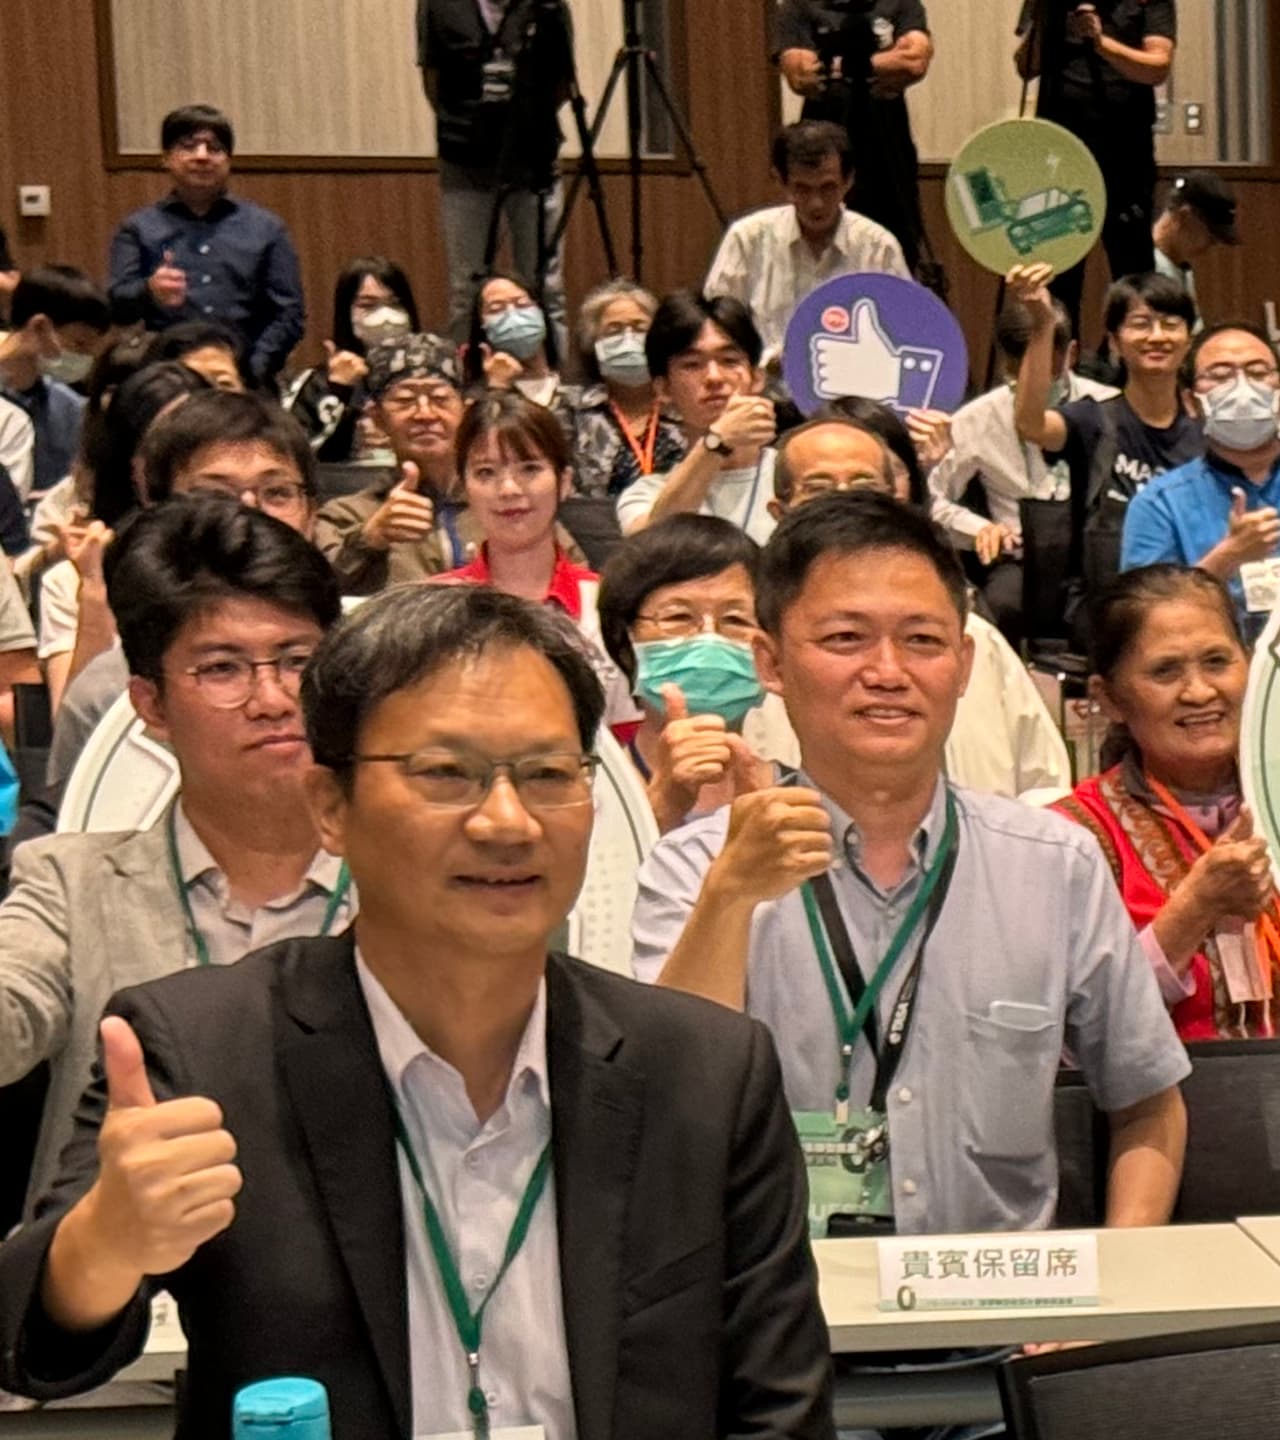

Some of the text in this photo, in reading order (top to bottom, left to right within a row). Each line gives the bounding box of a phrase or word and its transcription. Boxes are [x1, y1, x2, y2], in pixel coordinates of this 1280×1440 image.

[900, 1248, 1079, 1280] 貴賓保留席
